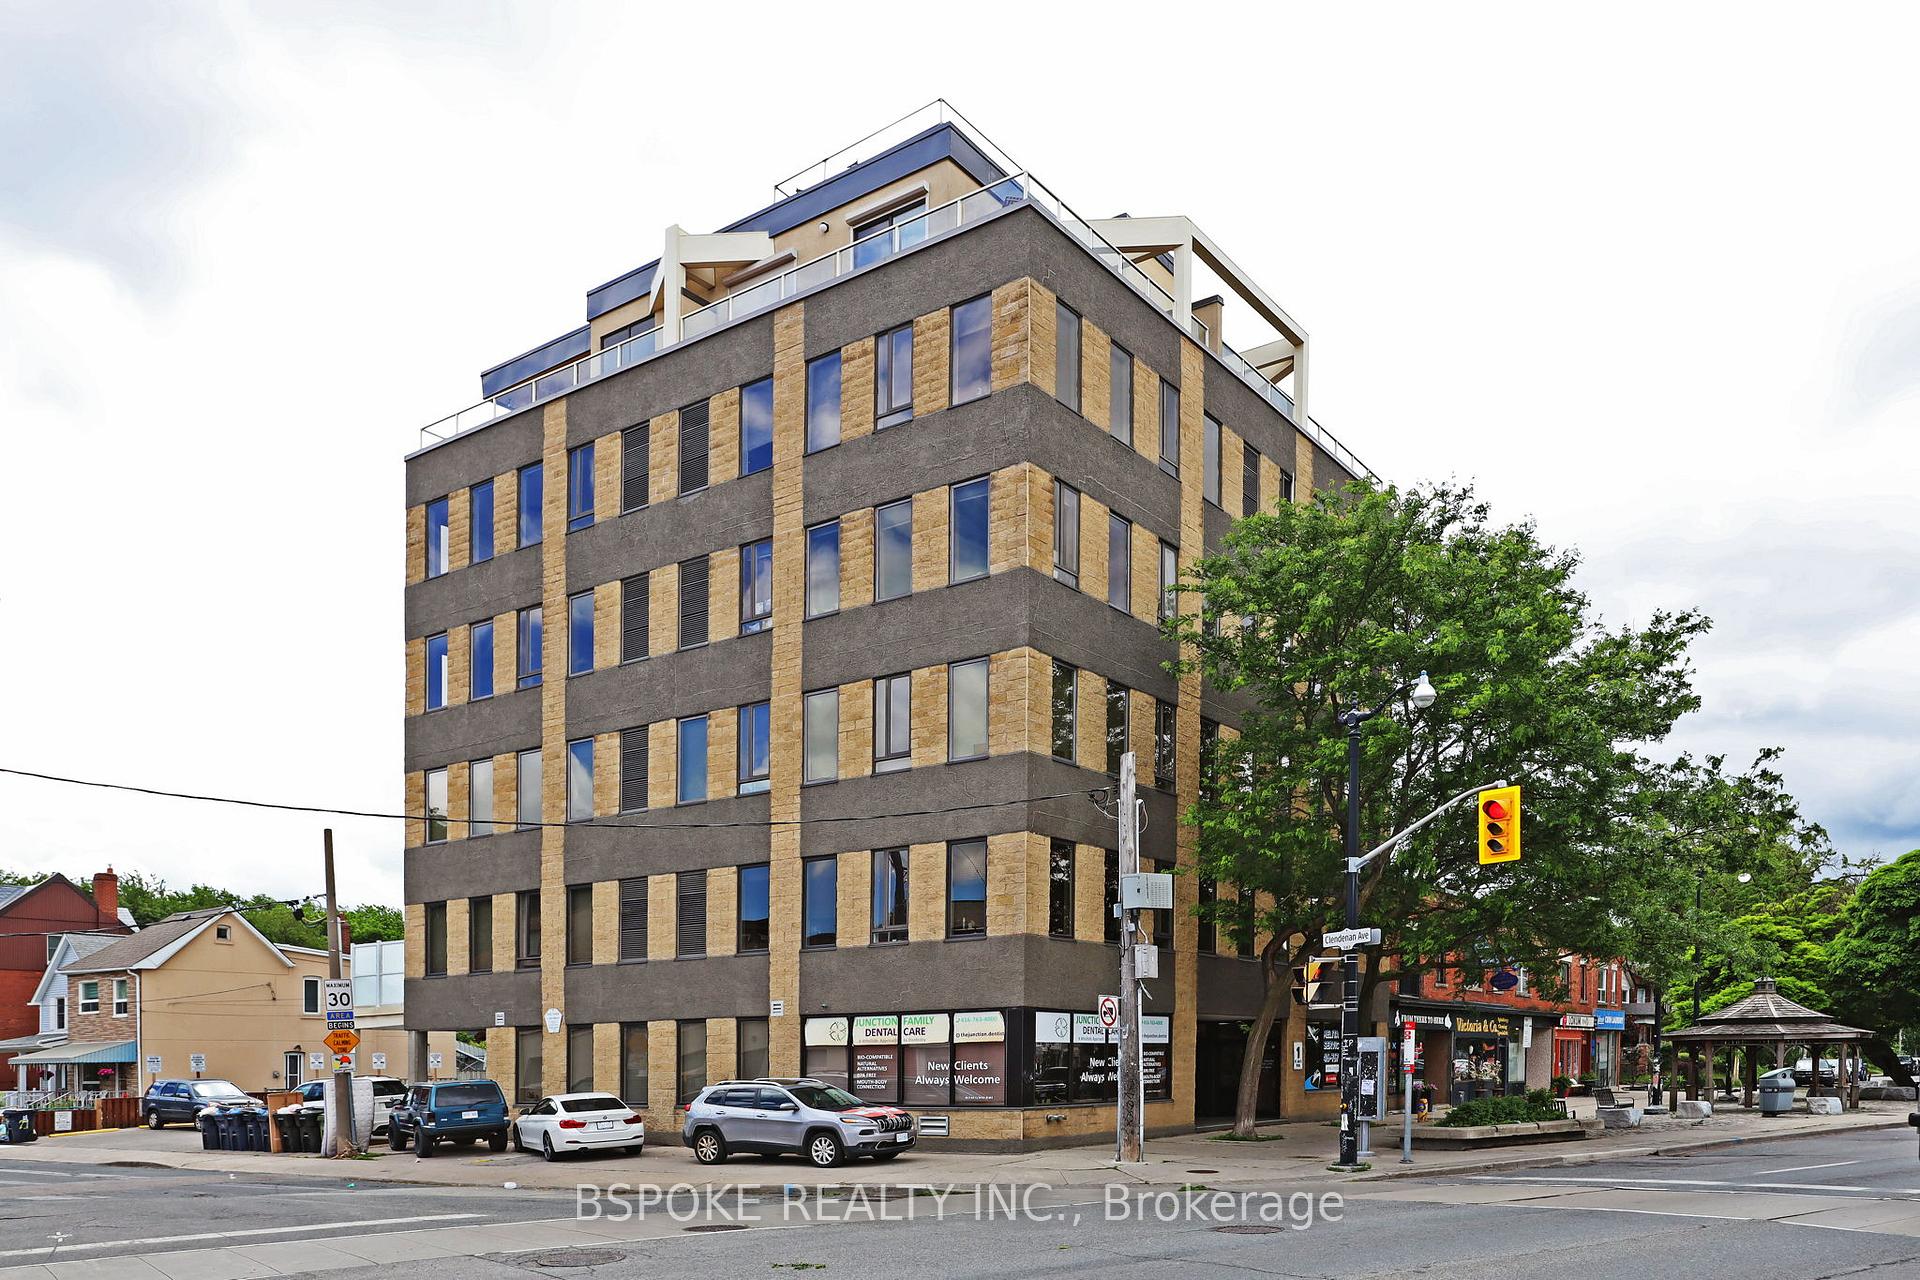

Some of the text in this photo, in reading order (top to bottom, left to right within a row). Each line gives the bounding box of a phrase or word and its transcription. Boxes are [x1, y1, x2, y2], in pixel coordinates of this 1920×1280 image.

[1325, 931, 1369, 944] Clendenan Ave
[328, 992, 350, 1006] 30
[855, 1016, 934, 1027] JUNCTION FAMILY
[1456, 1017, 1482, 1032] Victoria
[1483, 1019, 1489, 1032] &
[865, 1027, 926, 1037] DENTAL CARE
[927, 1060, 989, 1071] New Clients
[1089, 1057, 1106, 1067] New
[915, 1074, 1001, 1086] Always Welcome
[1080, 1072, 1105, 1084] Always
